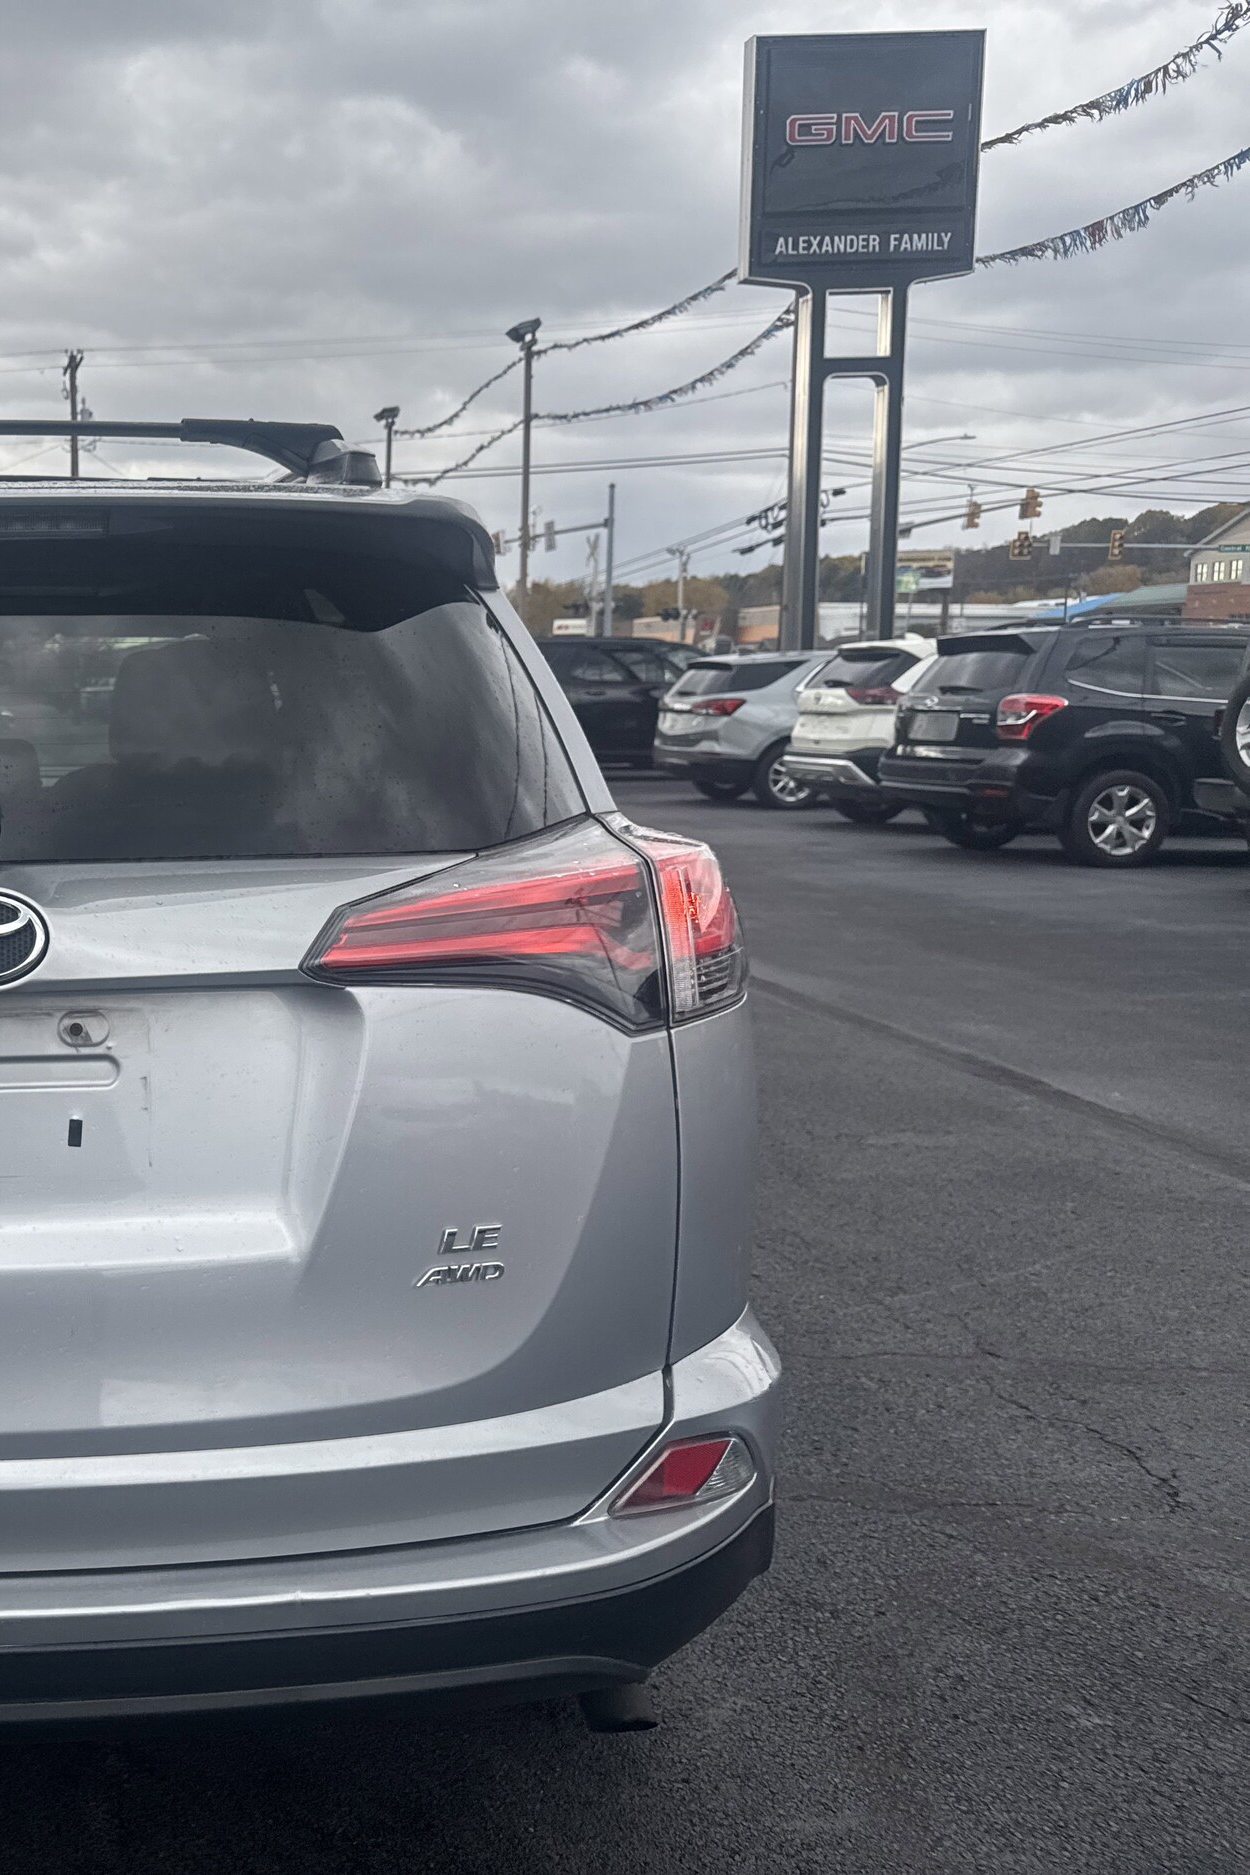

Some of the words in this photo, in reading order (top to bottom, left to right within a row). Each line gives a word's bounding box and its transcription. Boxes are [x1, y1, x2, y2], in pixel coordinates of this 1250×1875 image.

[786, 110, 954, 145] GMC
[775, 235, 880, 255] ALEXANDER
[889, 232, 952, 252] FAMILY
[437, 1223, 503, 1254] LE
[414, 1261, 505, 1288] AWD
